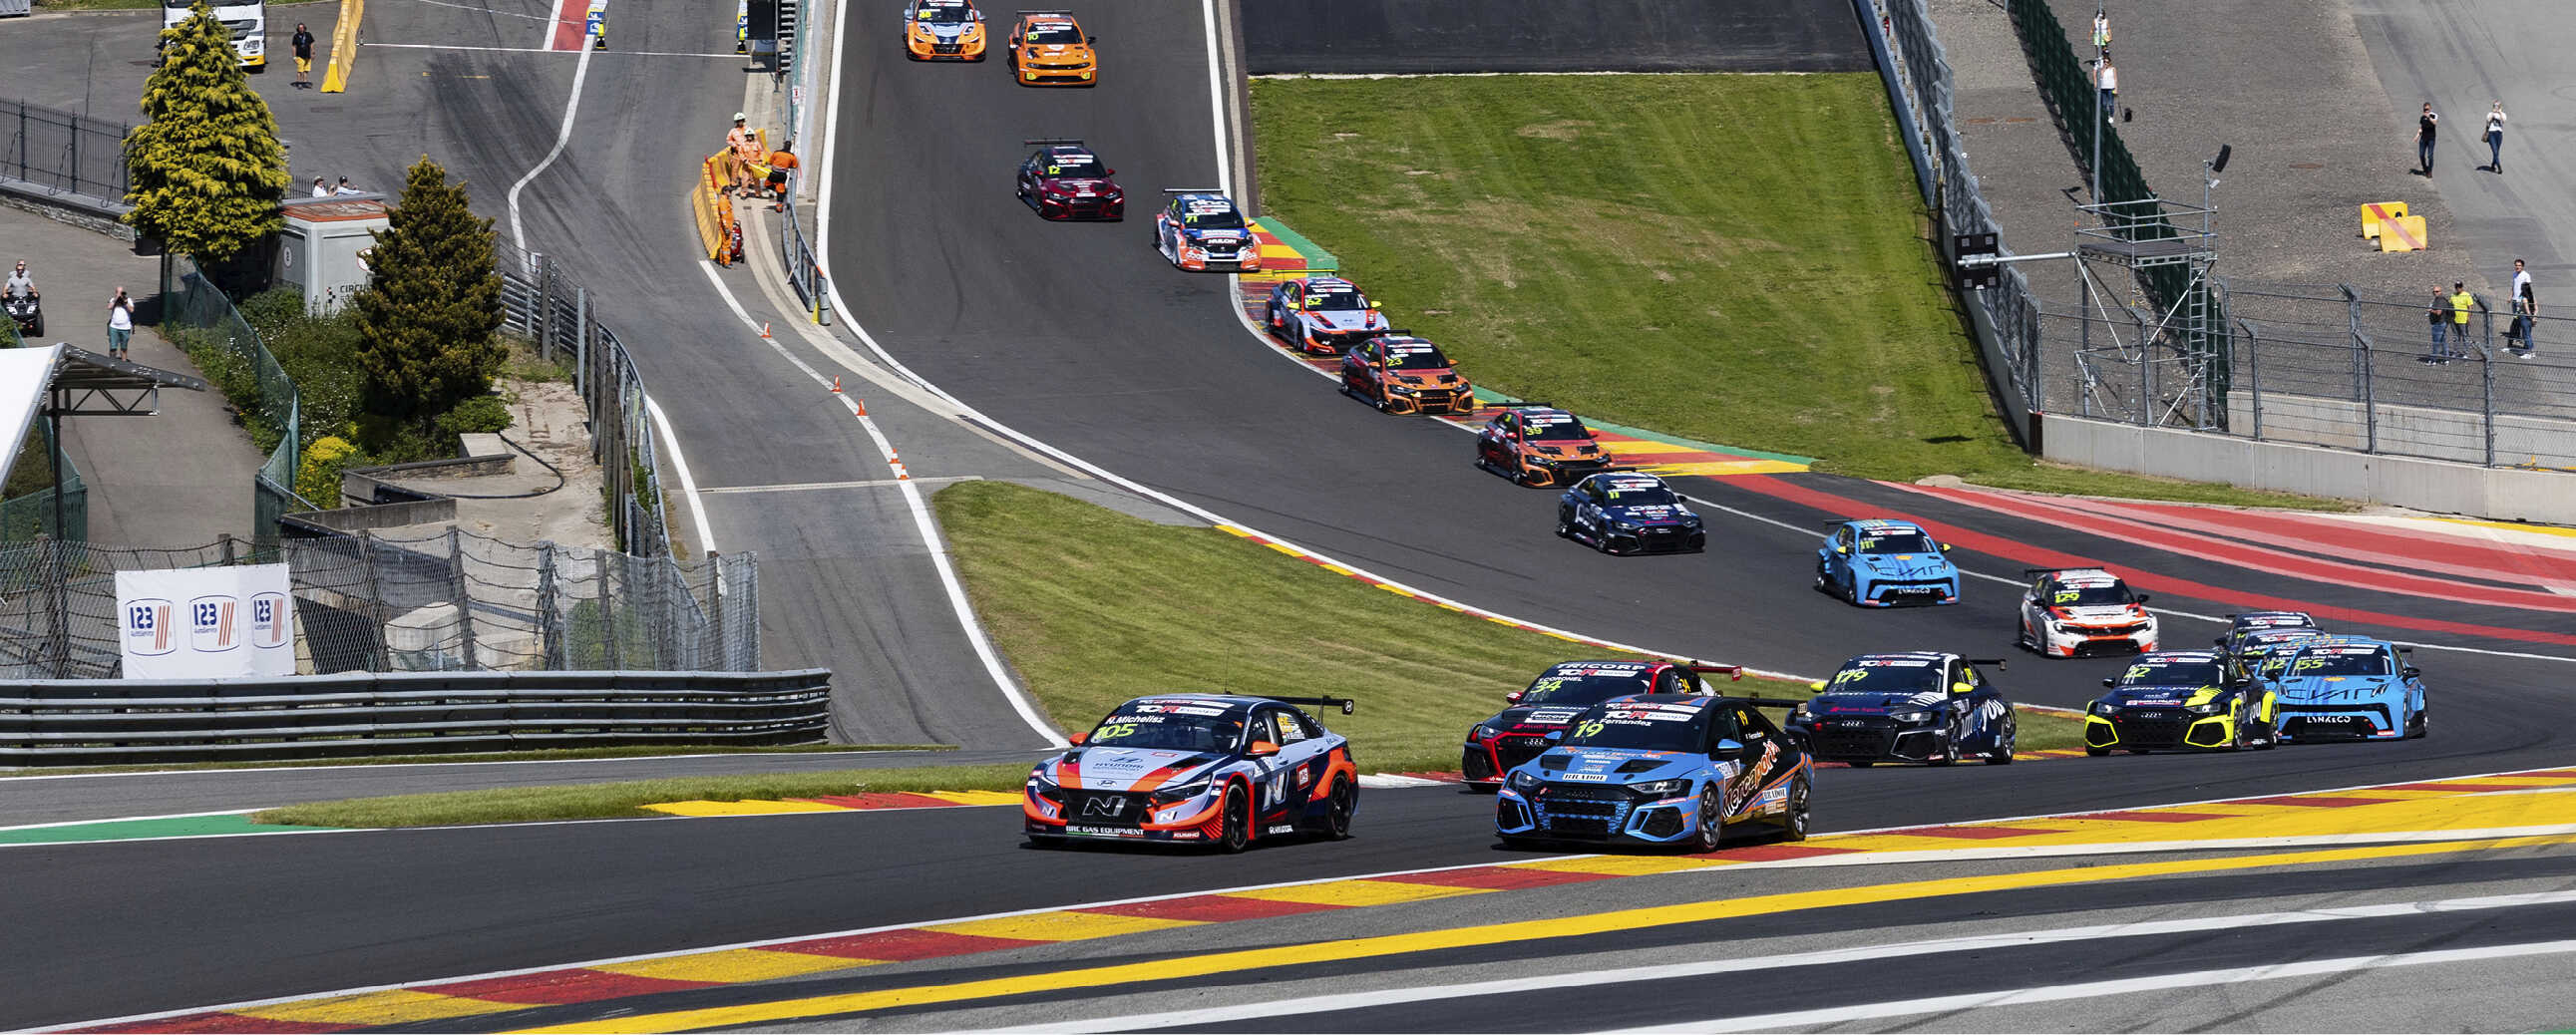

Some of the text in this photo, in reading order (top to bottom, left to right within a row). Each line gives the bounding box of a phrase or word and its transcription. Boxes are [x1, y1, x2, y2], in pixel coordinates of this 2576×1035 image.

[130, 606, 154, 629] 123
[193, 603, 217, 626] 123
[253, 599, 271, 623] 123
[1574, 723, 1604, 738] 19
[1100, 827, 1145, 836] EQUIPMENT
